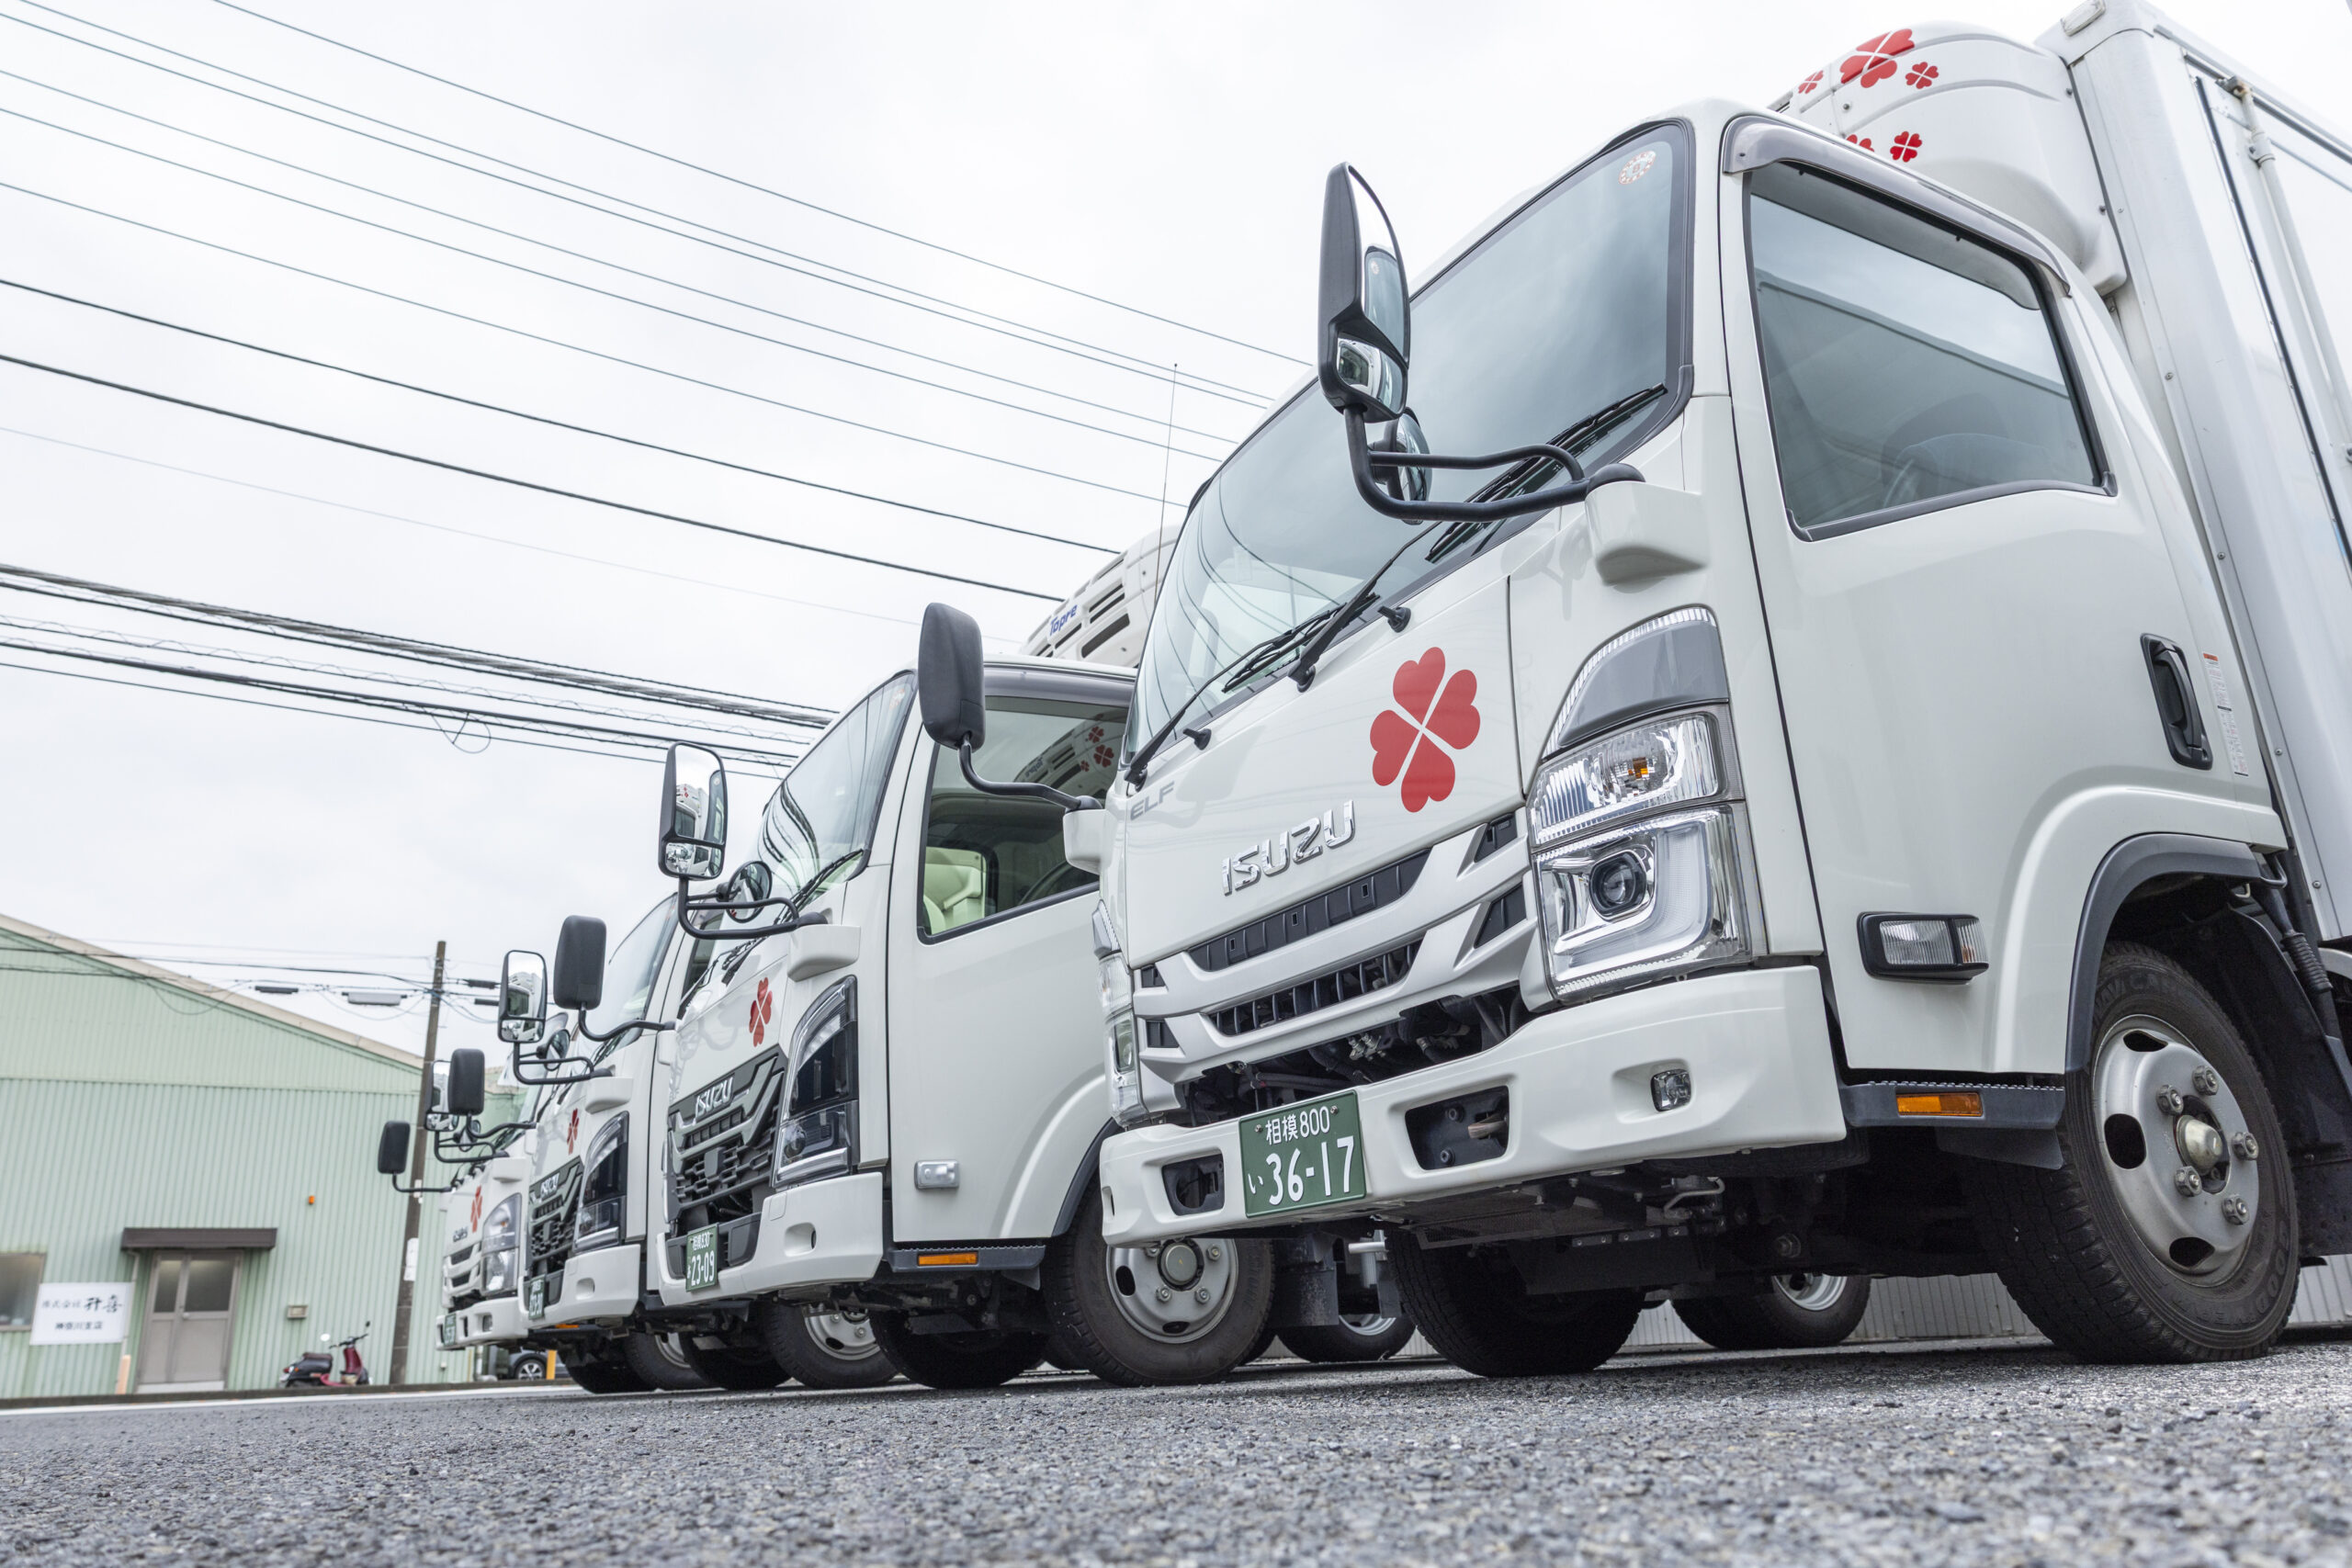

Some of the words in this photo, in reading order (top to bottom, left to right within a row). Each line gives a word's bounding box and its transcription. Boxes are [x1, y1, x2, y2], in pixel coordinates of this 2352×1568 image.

[1049, 604, 1078, 636] Topre
[1130, 781, 1175, 821] ELF
[1222, 800, 1355, 897] ISUZU
[695, 1077, 733, 1119] ISUZU
[1265, 1106, 1330, 1145] 相模800
[1248, 1173, 1263, 1194] い
[1266, 1135, 1354, 1205] 36-17
[691, 1250, 715, 1286] 23-09
